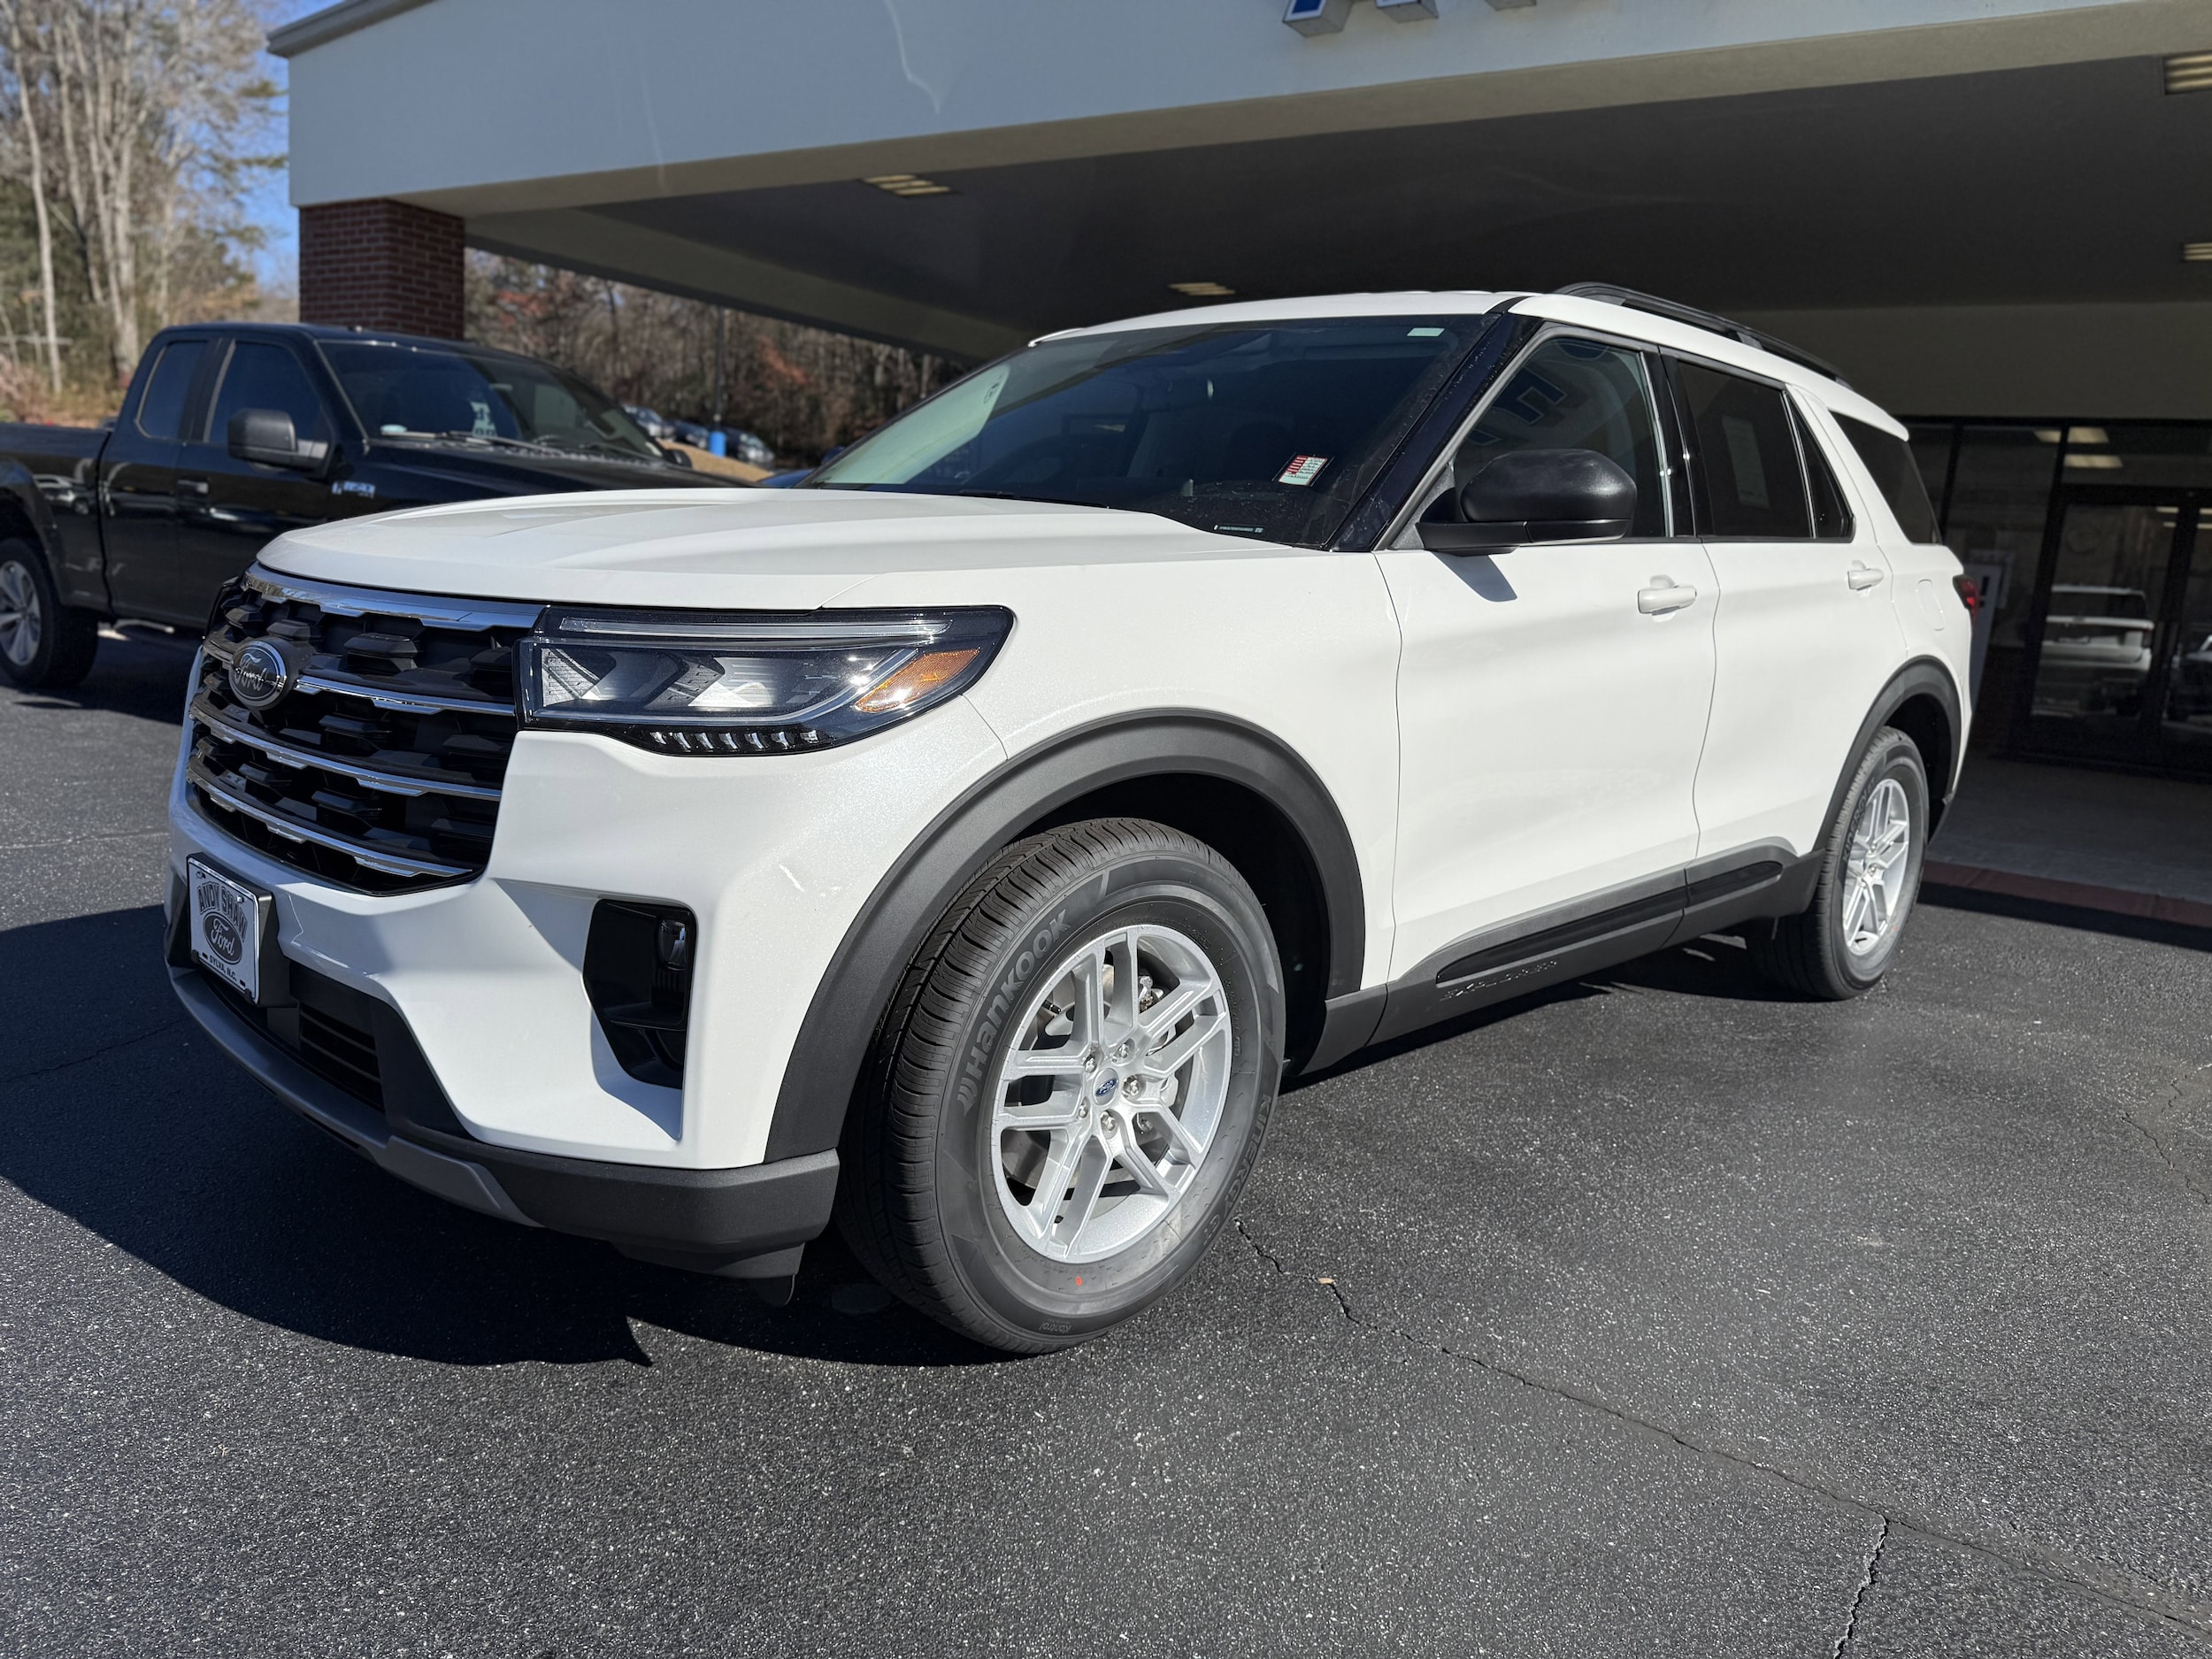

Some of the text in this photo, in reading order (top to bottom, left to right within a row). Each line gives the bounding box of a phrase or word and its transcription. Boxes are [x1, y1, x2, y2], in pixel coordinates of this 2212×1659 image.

[234, 653, 267, 691] Ford
[197, 882, 248, 942] ANDY SHAW
[211, 918, 234, 956] Ford
[1040, 1323, 1071, 1333] Kontrol
